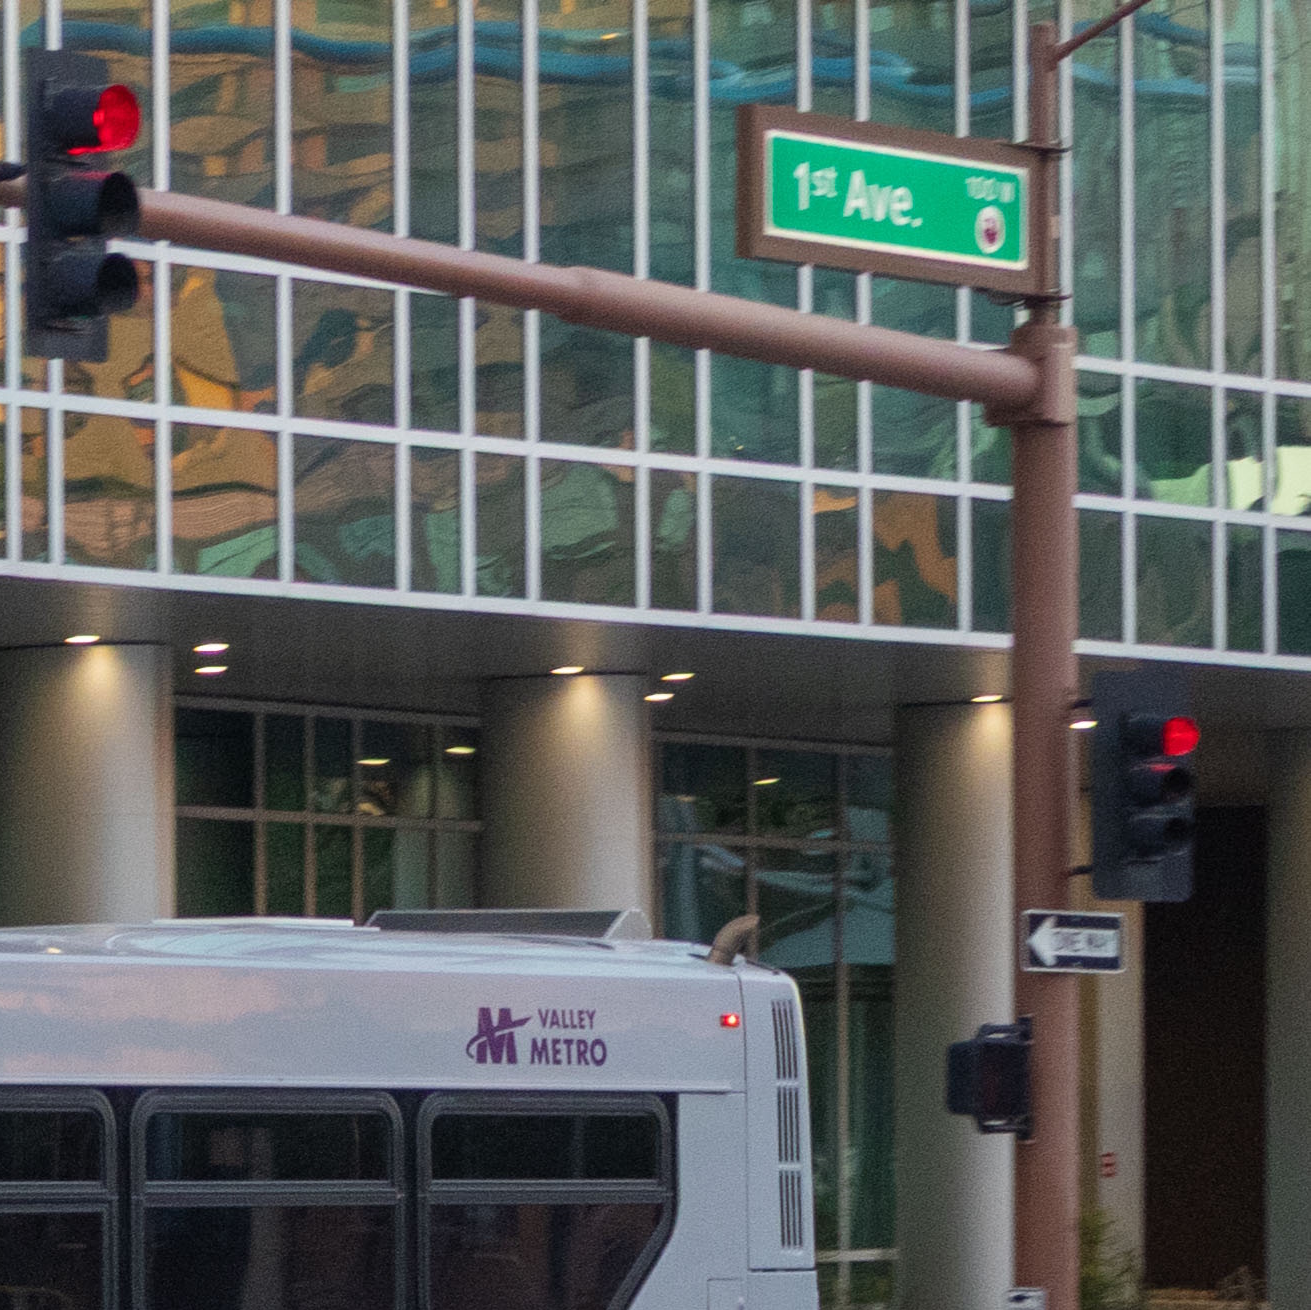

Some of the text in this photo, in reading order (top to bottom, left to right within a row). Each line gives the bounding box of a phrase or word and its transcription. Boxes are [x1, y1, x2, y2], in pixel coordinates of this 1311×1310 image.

[793, 161, 924, 228] 1st Ave.
[537, 1008, 596, 1030] VALLEY
[530, 1037, 608, 1067] METRO
